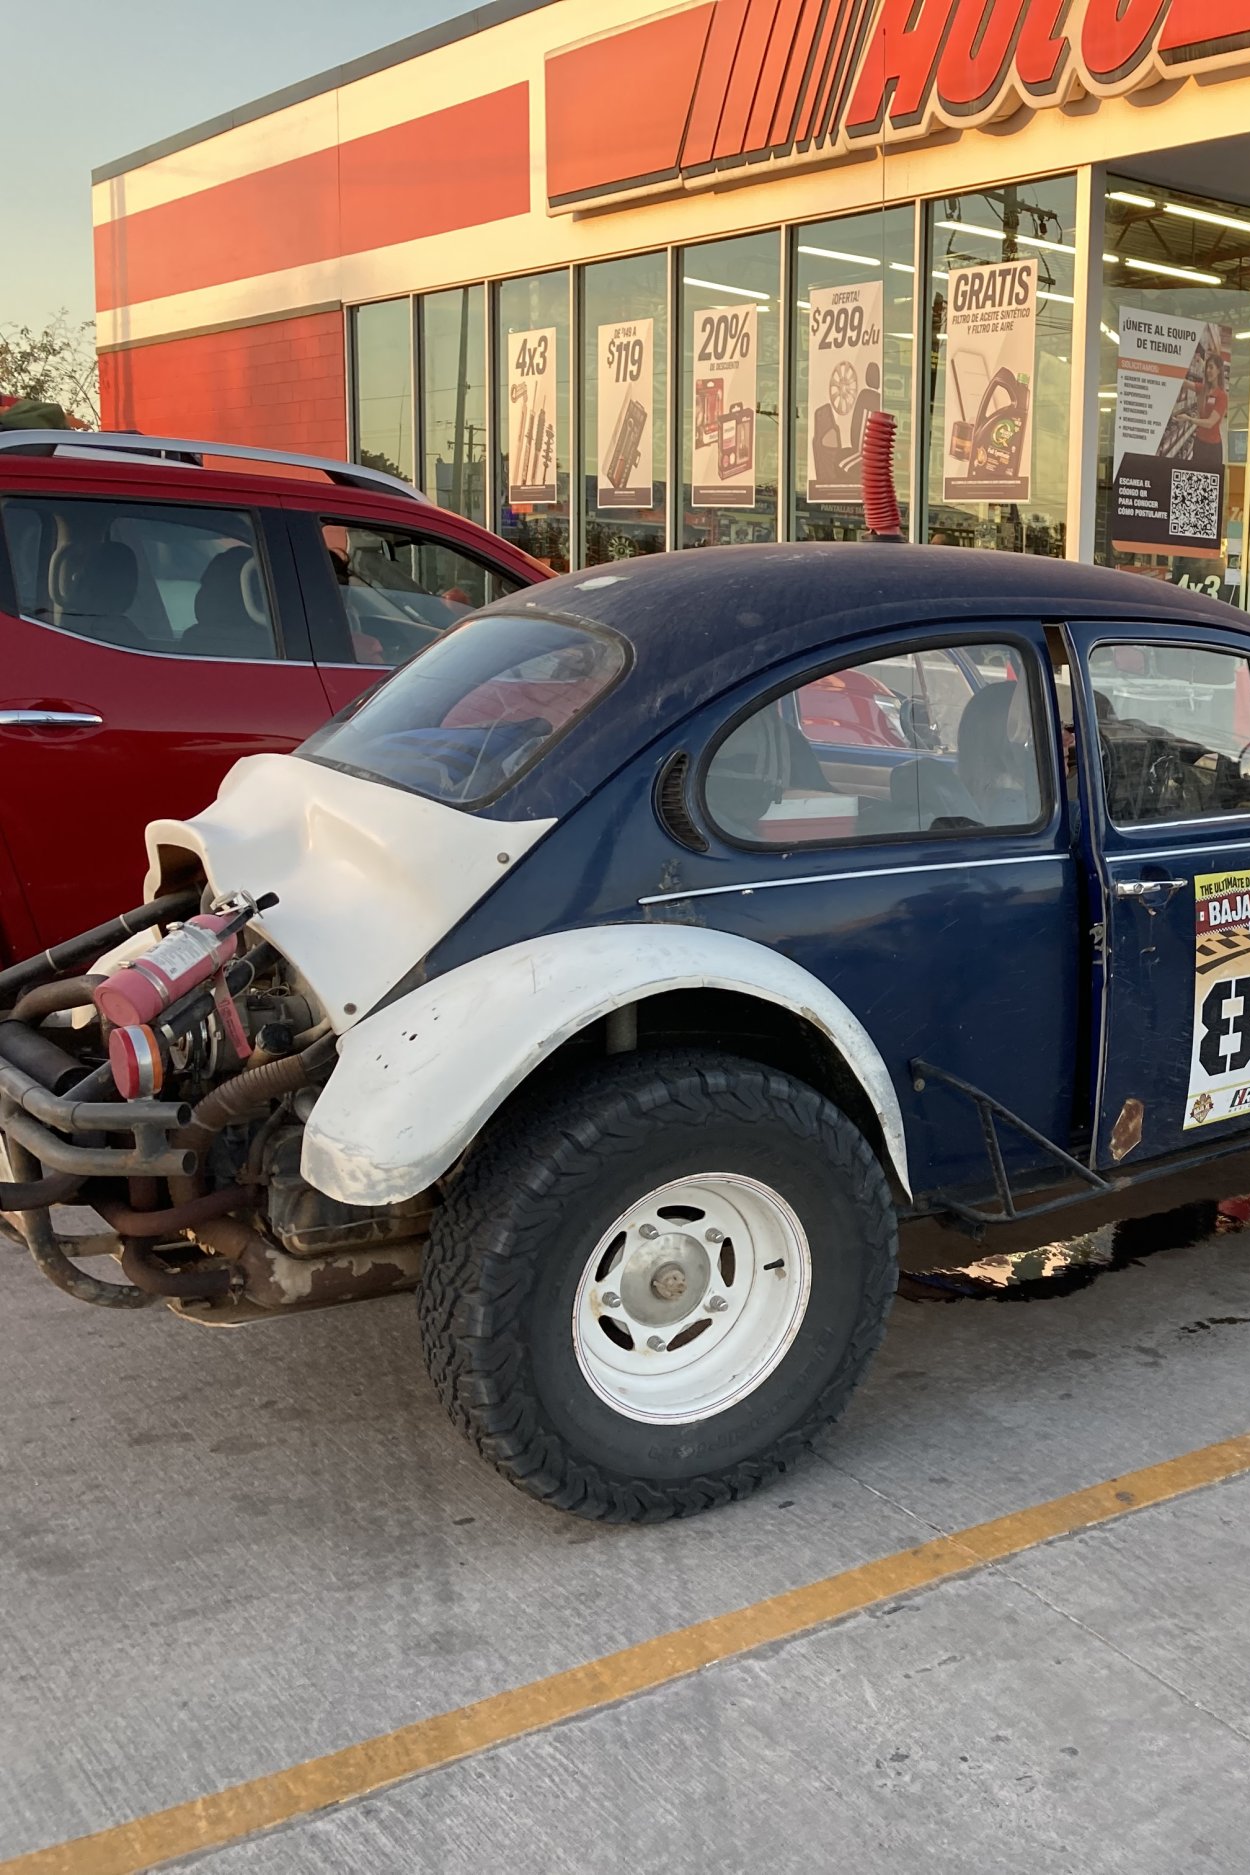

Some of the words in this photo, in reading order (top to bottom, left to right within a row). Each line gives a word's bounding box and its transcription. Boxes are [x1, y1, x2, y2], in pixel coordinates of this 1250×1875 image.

[832, 290, 860, 305] ¡OFERTA!
[953, 265, 1032, 312] GRATIS
[952, 313, 971, 325] FILTRO
[971, 313, 979, 323] DE
[980, 311, 1000, 321] ACEITE
[1000, 307, 1031, 320] SINTÉTICO
[614, 328, 620, 339] DE
[697, 311, 751, 361] 20%
[811, 305, 864, 350] $299
[967, 325, 972, 335] Y
[972, 322, 991, 334] FILTRO
[991, 322, 999, 333] DE
[1000, 321, 1014, 332] AIRE
[1122, 317, 1153, 335] ¡ÚNETE
[1154, 325, 1165, 337] AL
[1167, 327, 1197, 342] EQUIPO
[515, 335, 549, 377] 4x3
[1137, 338, 1148, 350] DE
[1150, 340, 1182, 356] TIENDA!
[607, 339, 643, 383] $119
[1119, 477, 1144, 487] ESCANEA
[1144, 480, 1151, 488] EL
[1139, 489, 1148, 497] QR
[1118, 497, 1133, 506] PARA
[1133, 499, 1159, 509] CONOCER
[1118, 506, 1134, 516] CÓMO
[1200, 884, 1213, 896] THE
[1214, 876, 1245, 893] ULTIMATE
